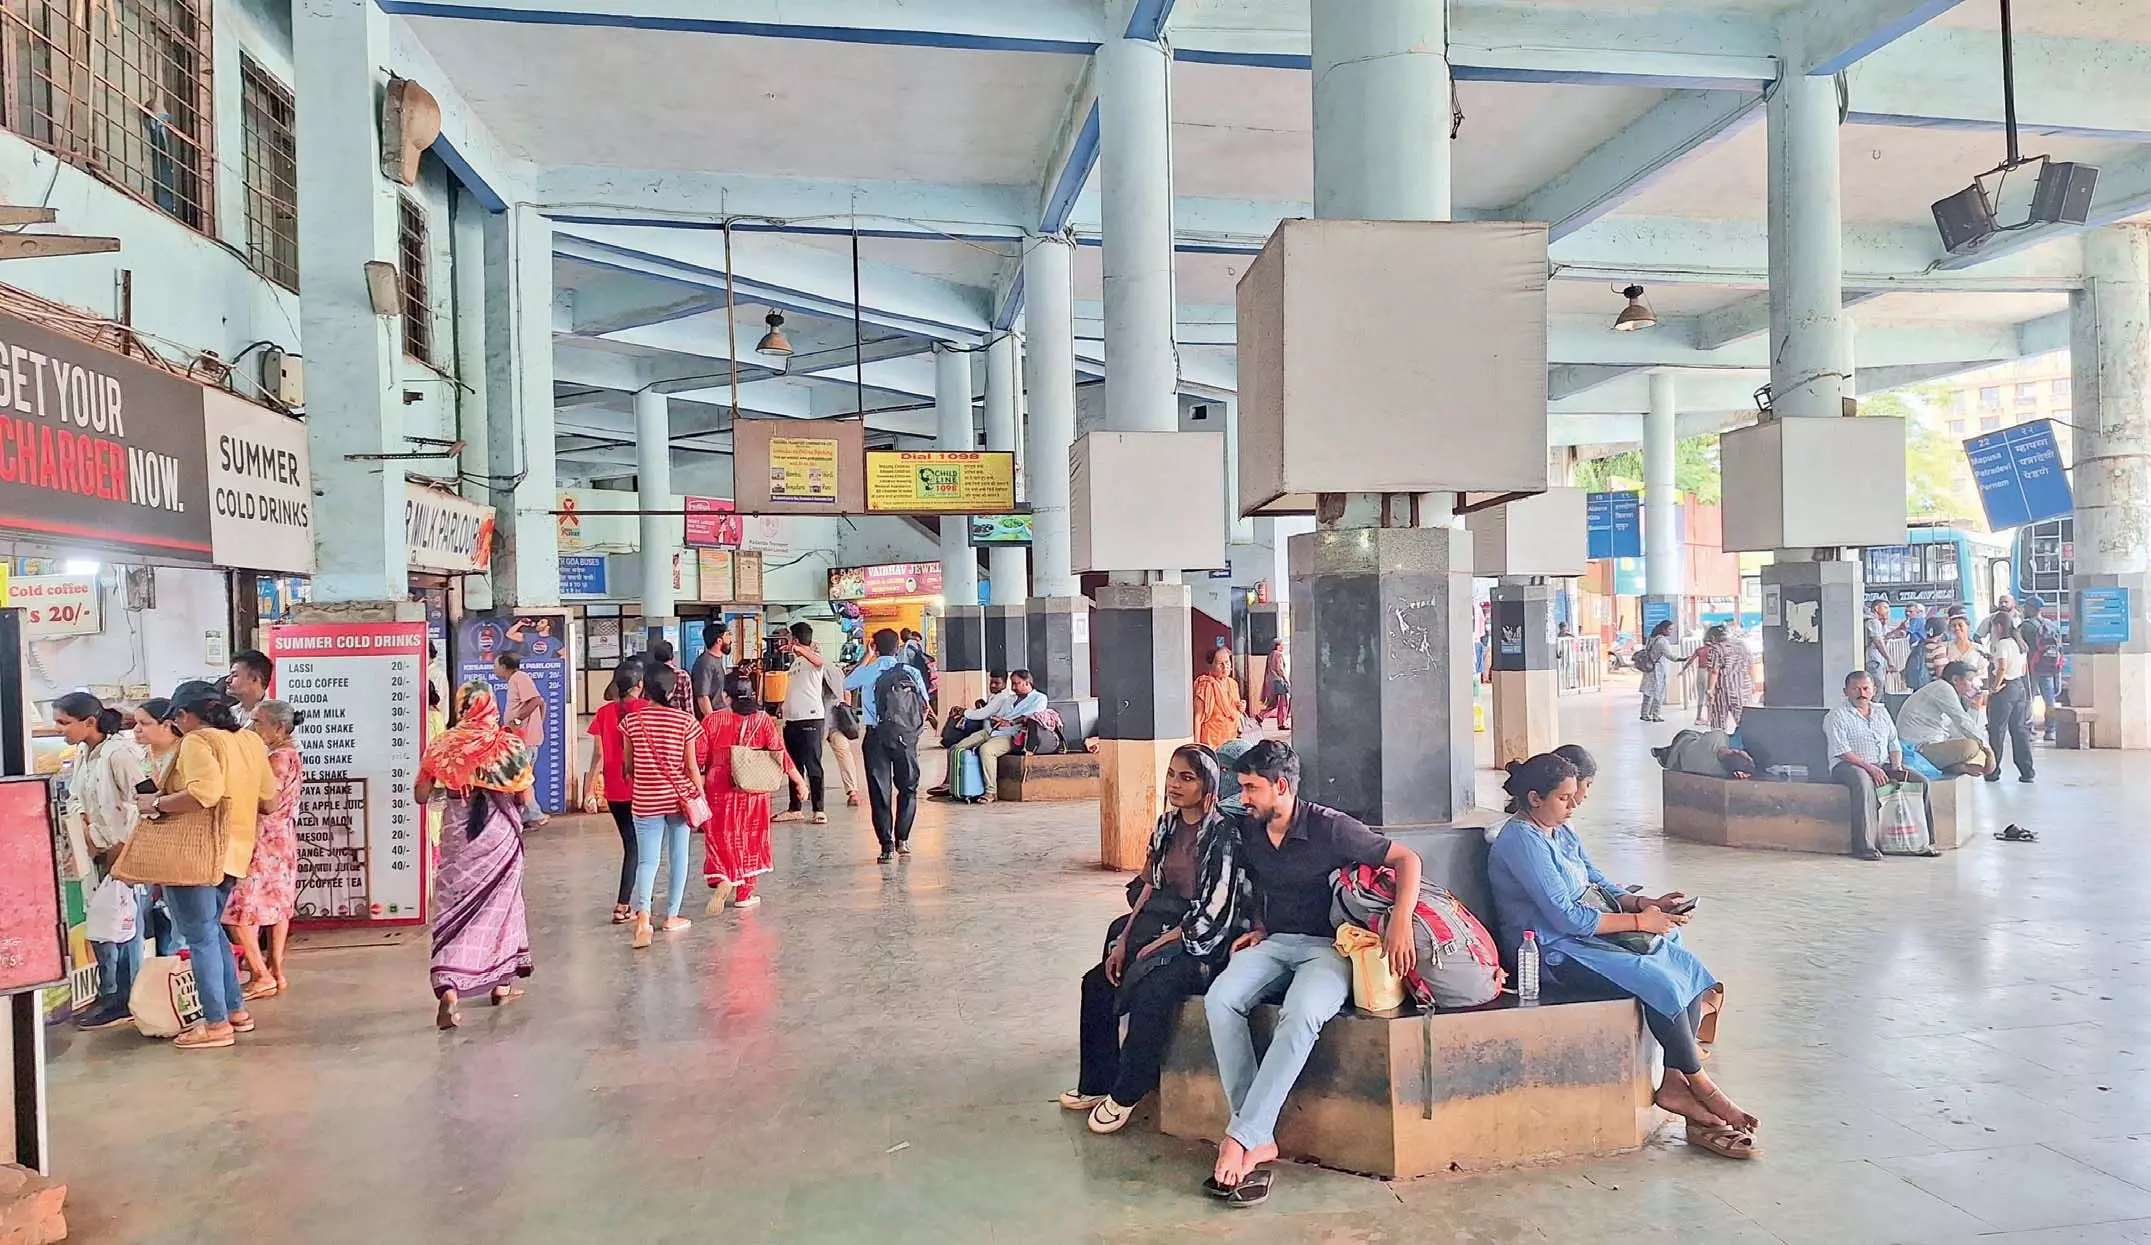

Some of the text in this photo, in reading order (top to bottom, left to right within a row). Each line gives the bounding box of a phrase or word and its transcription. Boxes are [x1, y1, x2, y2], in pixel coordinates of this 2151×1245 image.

[0, 338, 125, 438] GET YOUR
[0, 415, 185, 514] CHARGER NOW.
[219, 434, 301, 488] SUMMER
[934, 469, 958, 477] CHILD
[215, 486, 309, 529] COLD DRINKS
[411, 503, 440, 551] MILK
[437, 509, 480, 557] PARLOUR
[8, 582, 89, 597] Cold coffee
[49, 601, 91, 626] 20/-
[275, 634, 421, 650] SUMMER COLD DRINKS
[288, 663, 314, 673] LASSI
[391, 661, 410, 672] 20/-
[288, 677, 349, 689] COLD COFFEE
[391, 676, 410, 687] 20/-
[288, 693, 329, 704] FALOODA
[391, 692, 410, 703] 20/-
[302, 708, 346, 719] DAM MILK
[391, 707, 410, 718] 30/-
[301, 723, 354, 734] IKOO SHAKE
[391, 722, 410, 733] 30/-
[301, 739, 356, 749] NANA SHAKE
[391, 737, 410, 748] 30/-
[302, 754, 353, 765] NGO SHAKE
[301, 769, 348, 780] PLE SHAKE
[391, 768, 410, 779] 30/-
[300, 785, 353, 796] PAYA SHAKE
[391, 784, 410, 795] 30/-
[312, 800, 340, 811] APPLE
[342, 799, 364, 810] JUIC
[391, 799, 410, 810] 30/-
[297, 817, 319, 826] ATER
[391, 815, 410, 826] 30/-
[296, 831, 334, 842] MESODA
[391, 830, 410, 841] 20/-
[297, 849, 324, 858] RANGE
[391, 846, 410, 857] 40/-
[391, 861, 410, 872] 40/-
[296, 879, 307, 889] OT
